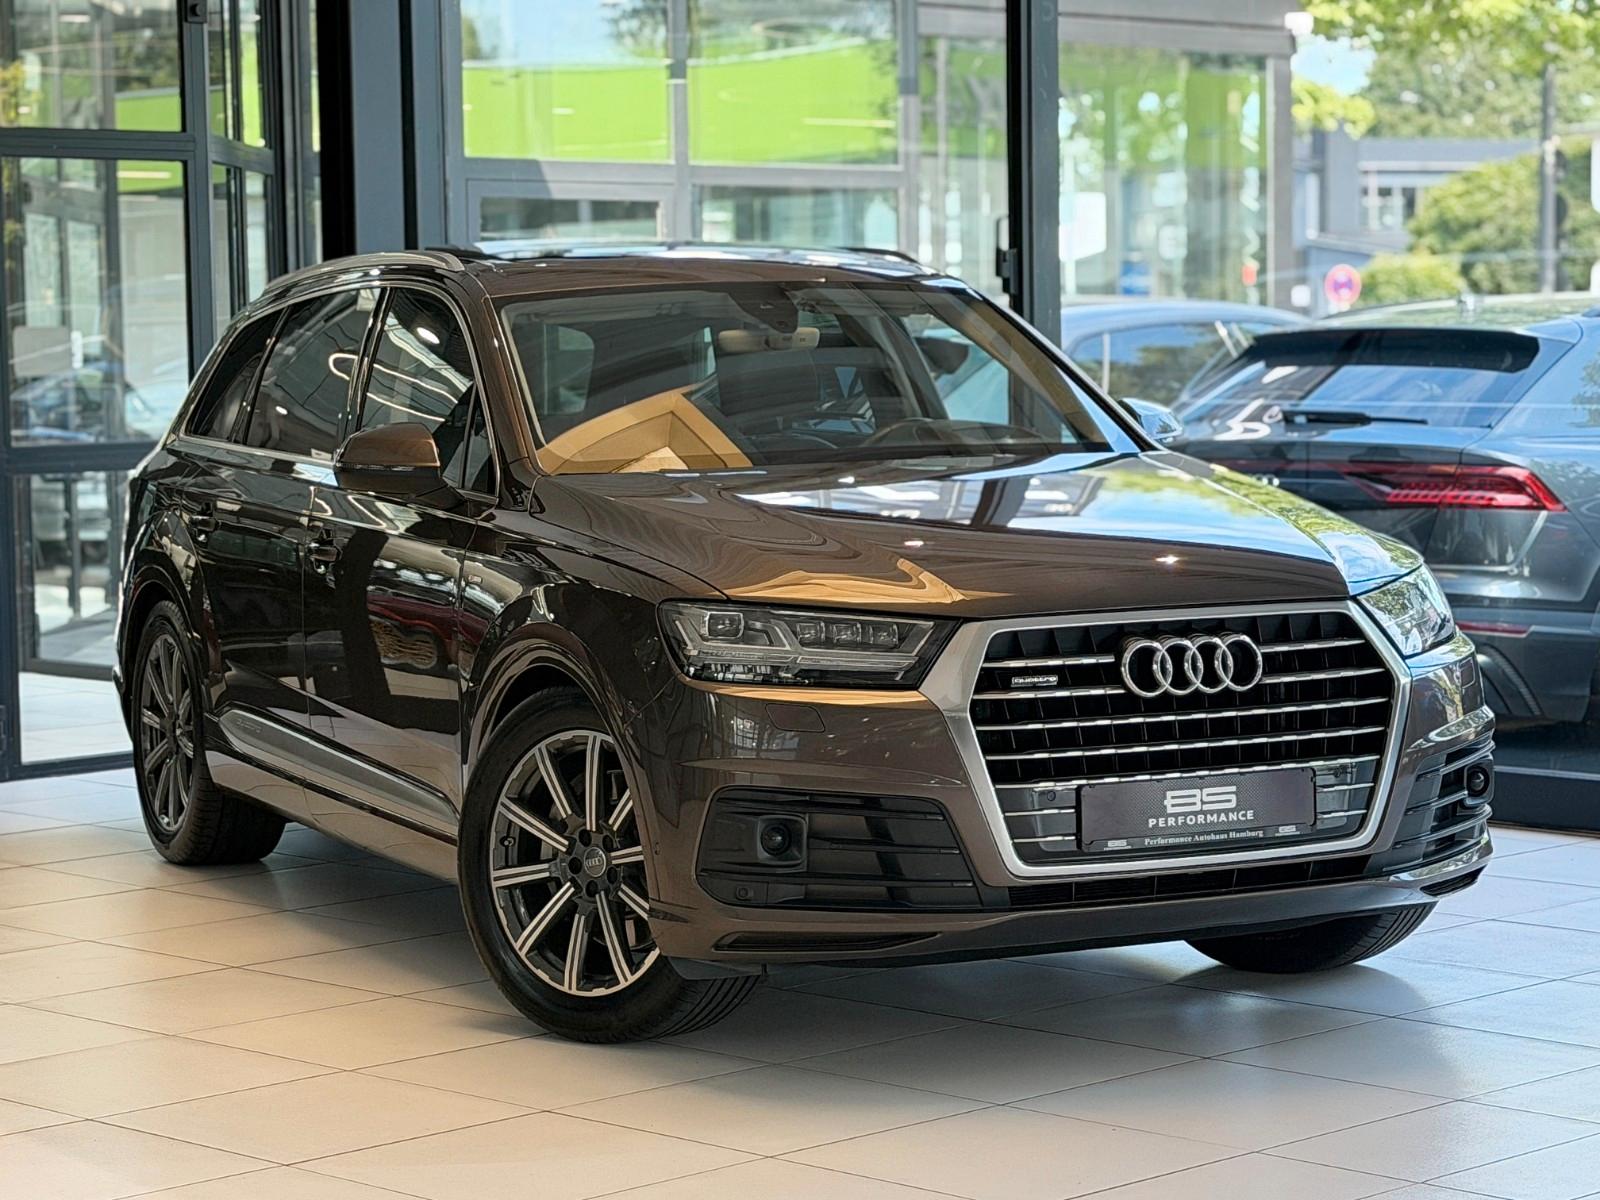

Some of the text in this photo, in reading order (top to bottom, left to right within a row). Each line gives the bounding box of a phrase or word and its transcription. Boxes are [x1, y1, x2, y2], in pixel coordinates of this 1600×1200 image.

[1148, 810, 1255, 828] PERFORMANCE
[1144, 836, 1193, 846] Performance
[1193, 832, 1228, 842] Autohaus
[1229, 830, 1264, 839] Hamburg
